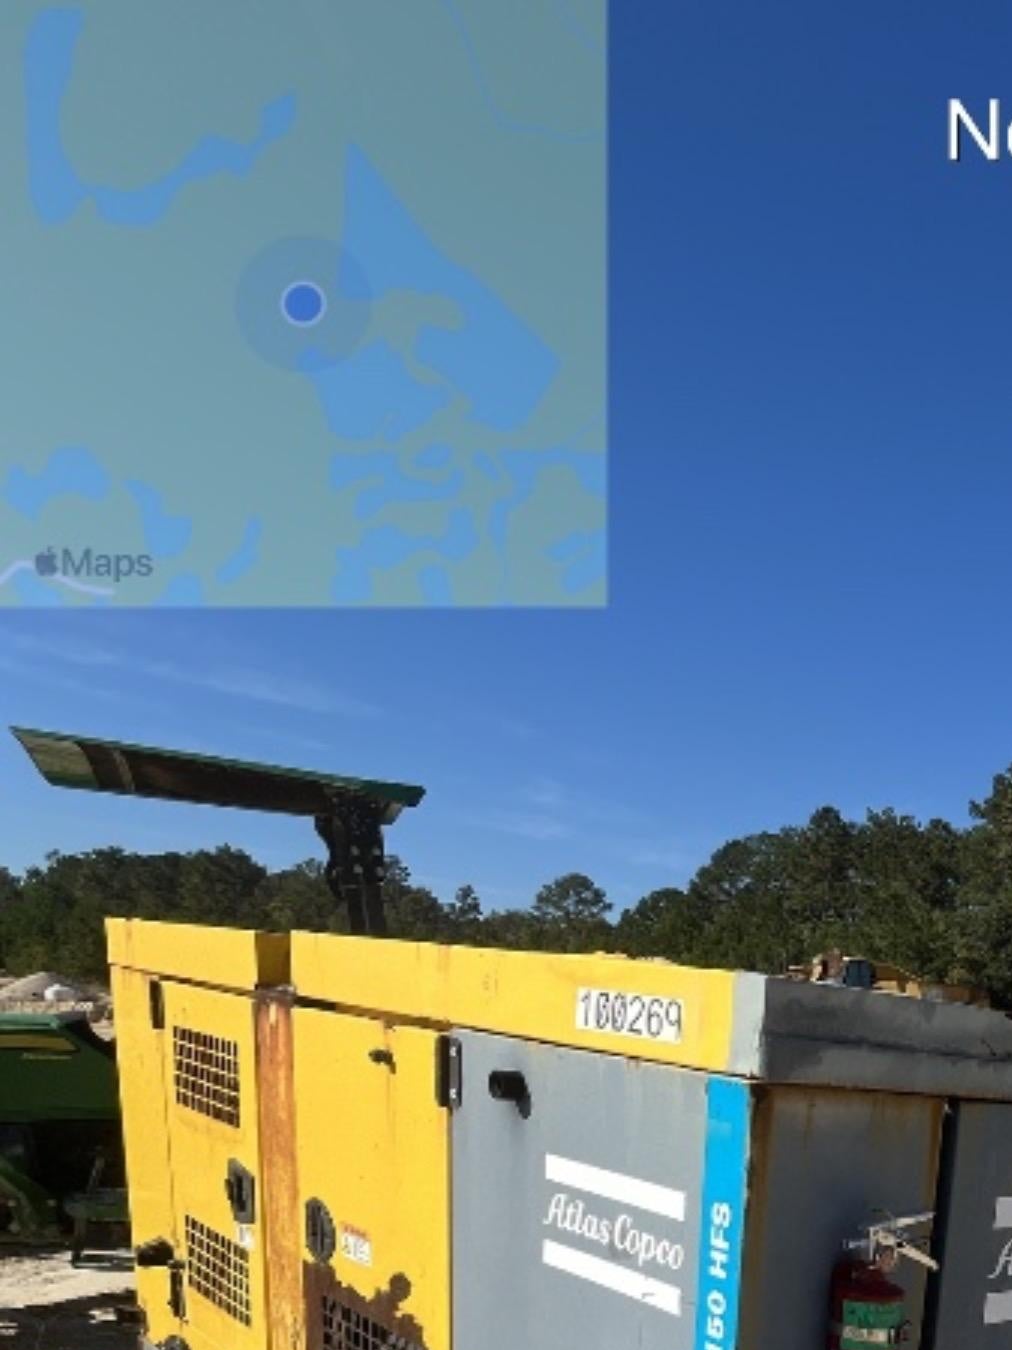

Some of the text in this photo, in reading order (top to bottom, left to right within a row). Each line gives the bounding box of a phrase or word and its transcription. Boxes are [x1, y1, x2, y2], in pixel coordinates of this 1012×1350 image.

[542, 1192, 685, 1272] Atlas Copco
[710, 1200, 734, 1280] HFS
